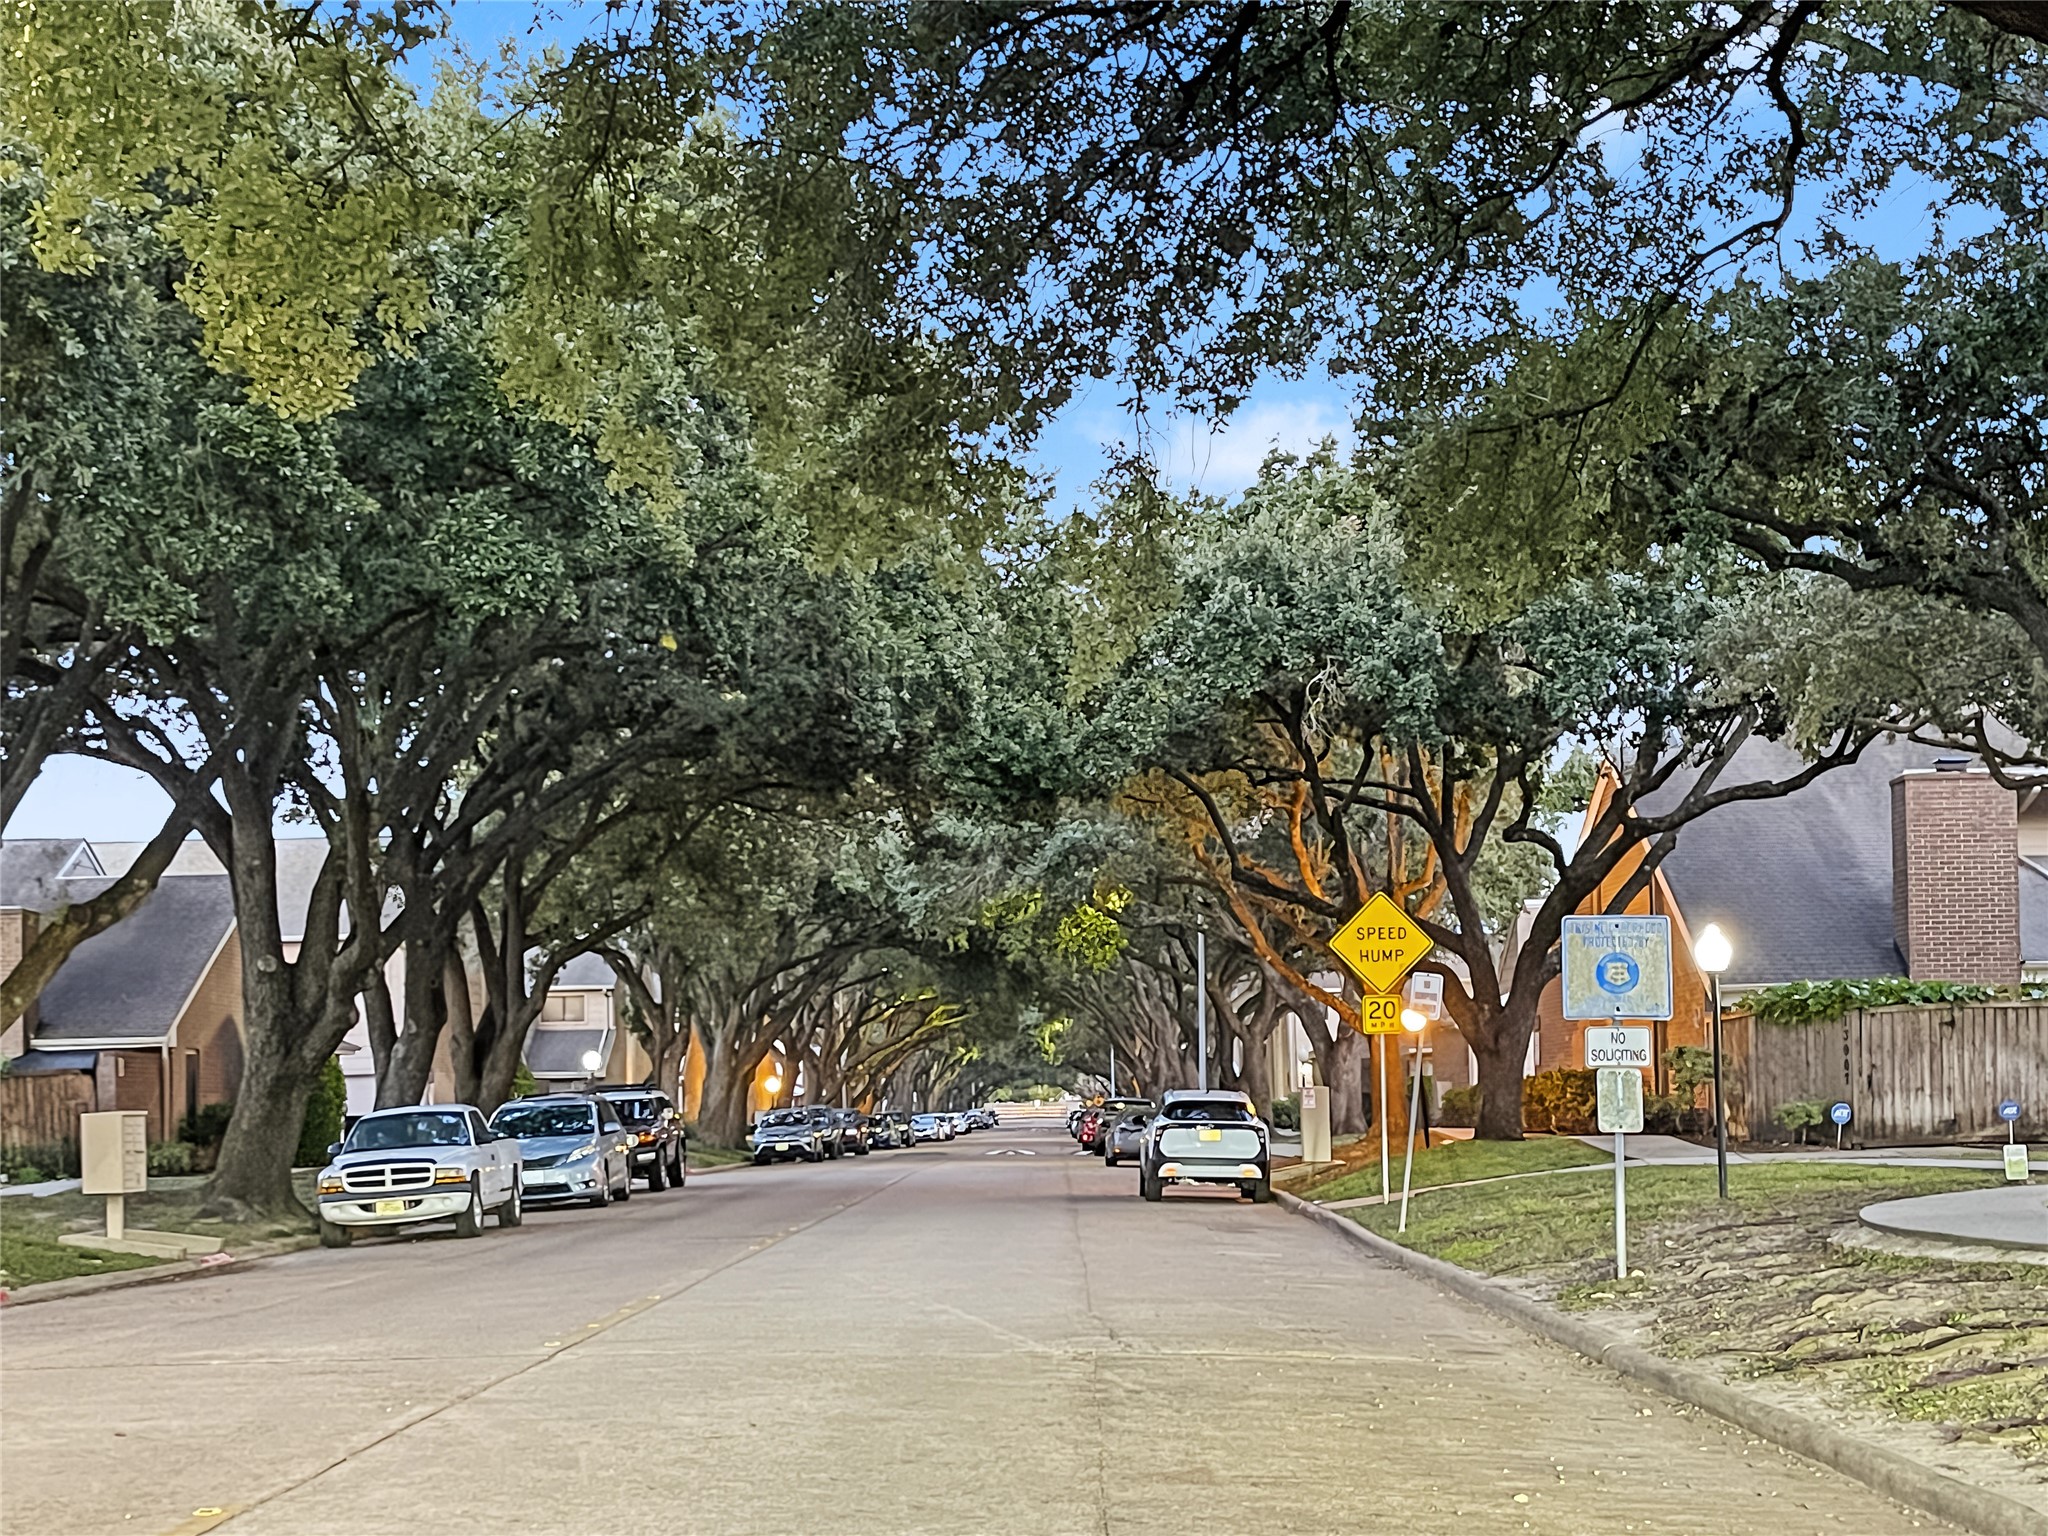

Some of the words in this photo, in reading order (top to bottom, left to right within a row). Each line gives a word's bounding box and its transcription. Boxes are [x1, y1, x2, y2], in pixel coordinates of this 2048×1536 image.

[1356, 926, 1407, 941] SPEED
[1359, 949, 1405, 963] HUMP
[1369, 1001, 1396, 1020] 20
[1610, 1032, 1626, 1044] NO
